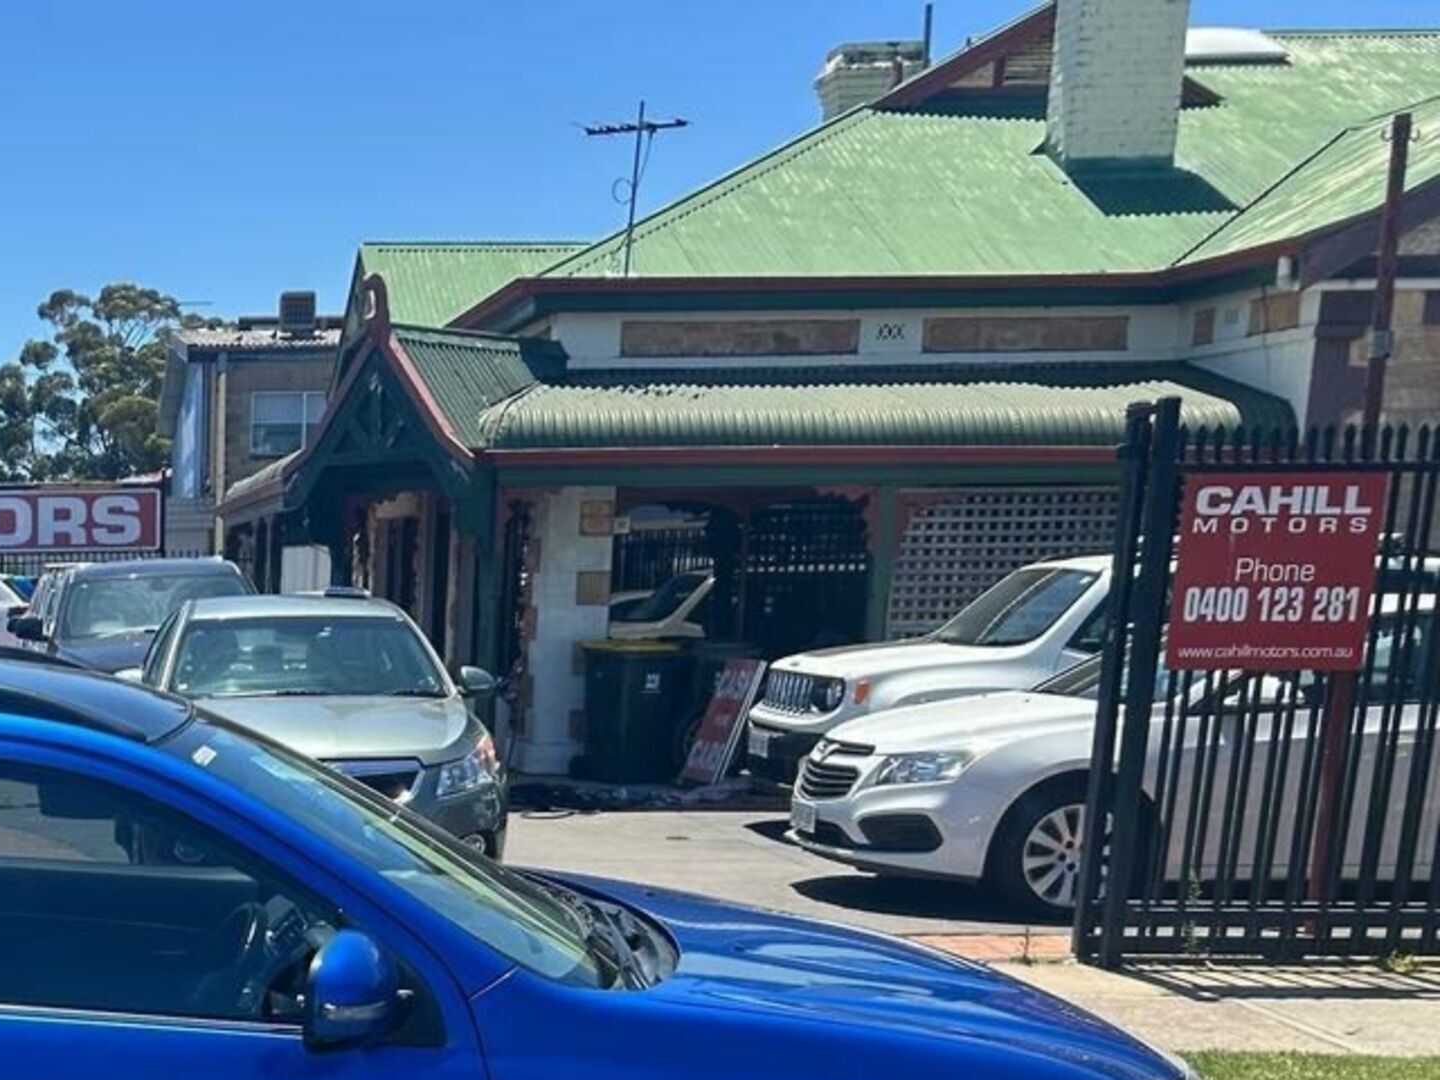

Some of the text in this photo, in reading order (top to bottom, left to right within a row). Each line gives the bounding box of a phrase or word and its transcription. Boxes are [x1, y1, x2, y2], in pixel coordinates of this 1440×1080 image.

[1195, 485, 1371, 516] CAHILL
[1192, 517, 1368, 533] MOTORS
[1234, 557, 1316, 582] Phone
[1183, 587, 1359, 622] 0400 123 281
[1178, 644, 1353, 658] www.cahillmotors.com.au
